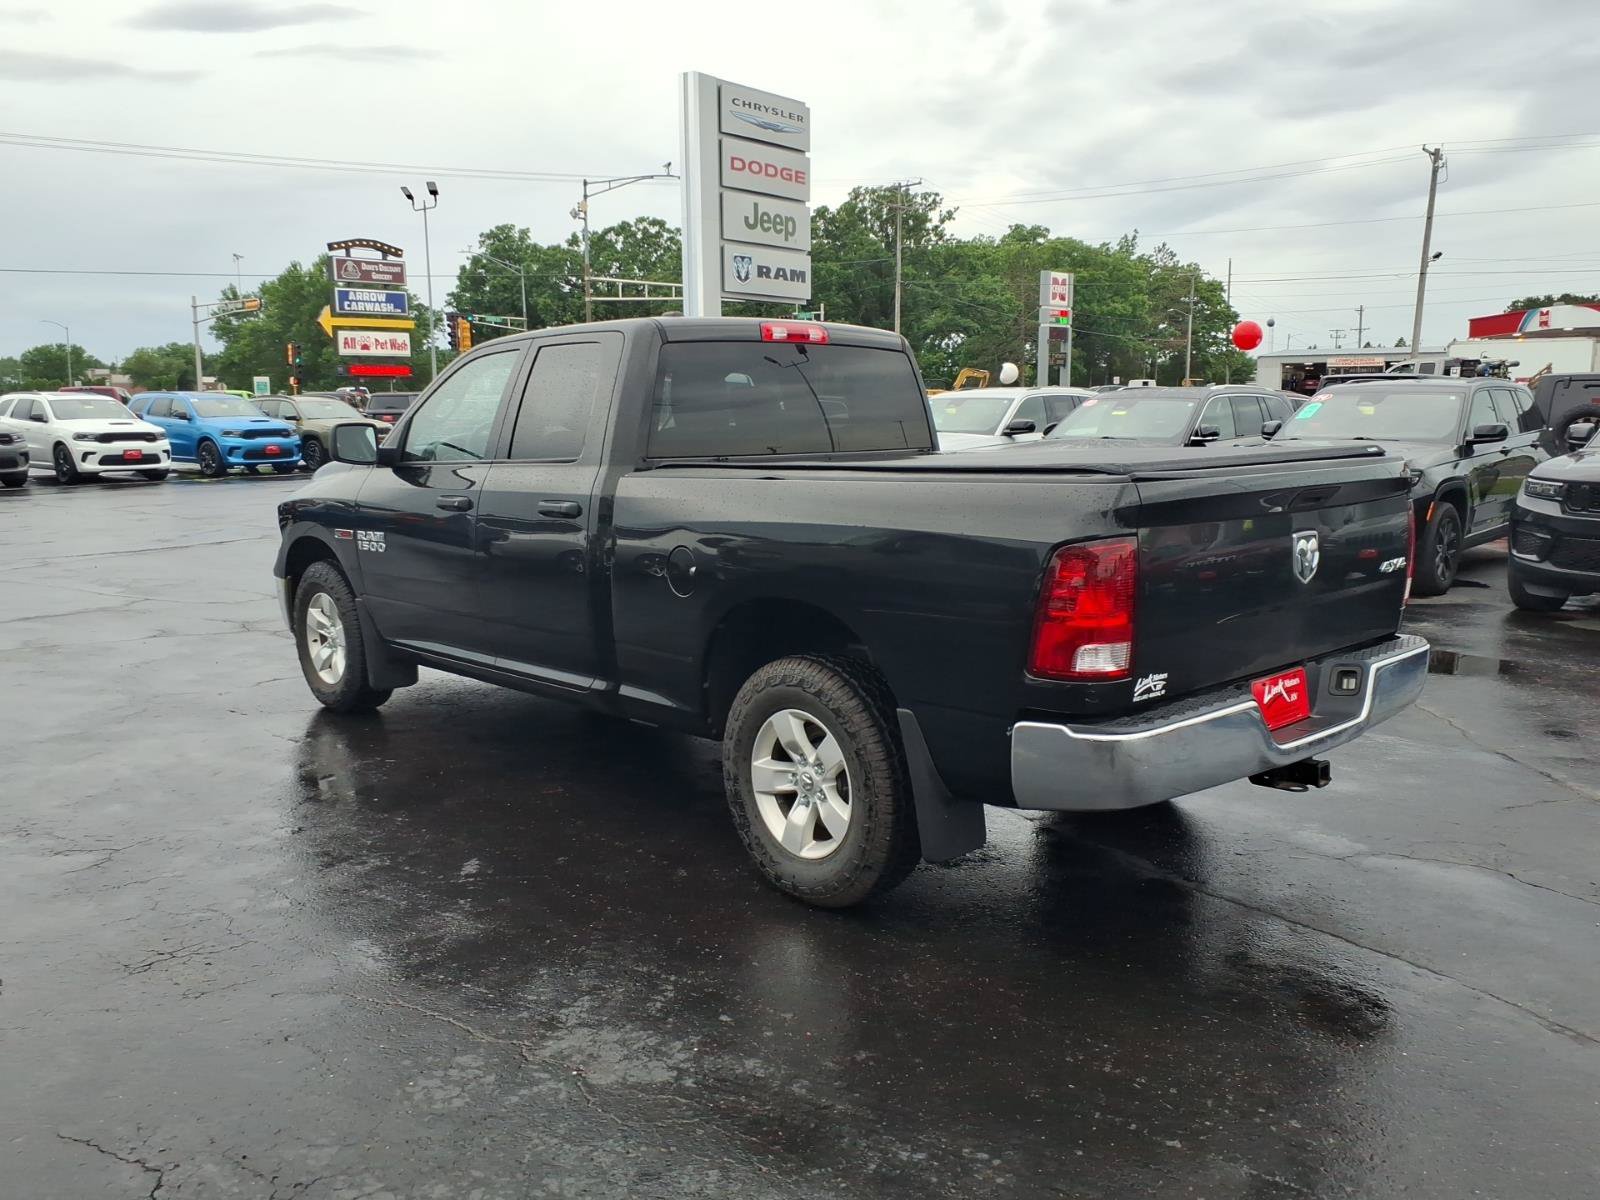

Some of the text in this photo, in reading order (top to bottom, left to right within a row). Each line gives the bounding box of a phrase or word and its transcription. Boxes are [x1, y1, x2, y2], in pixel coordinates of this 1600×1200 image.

[731, 97, 804, 123] CHRYSLER
[730, 156, 806, 184] DODGE
[744, 202, 797, 242] Jeep
[756, 264, 806, 283] RAM
[348, 291, 386, 302] ARROW
[343, 337, 409, 351] All Pet Wash
[358, 541, 387, 552] 1500
